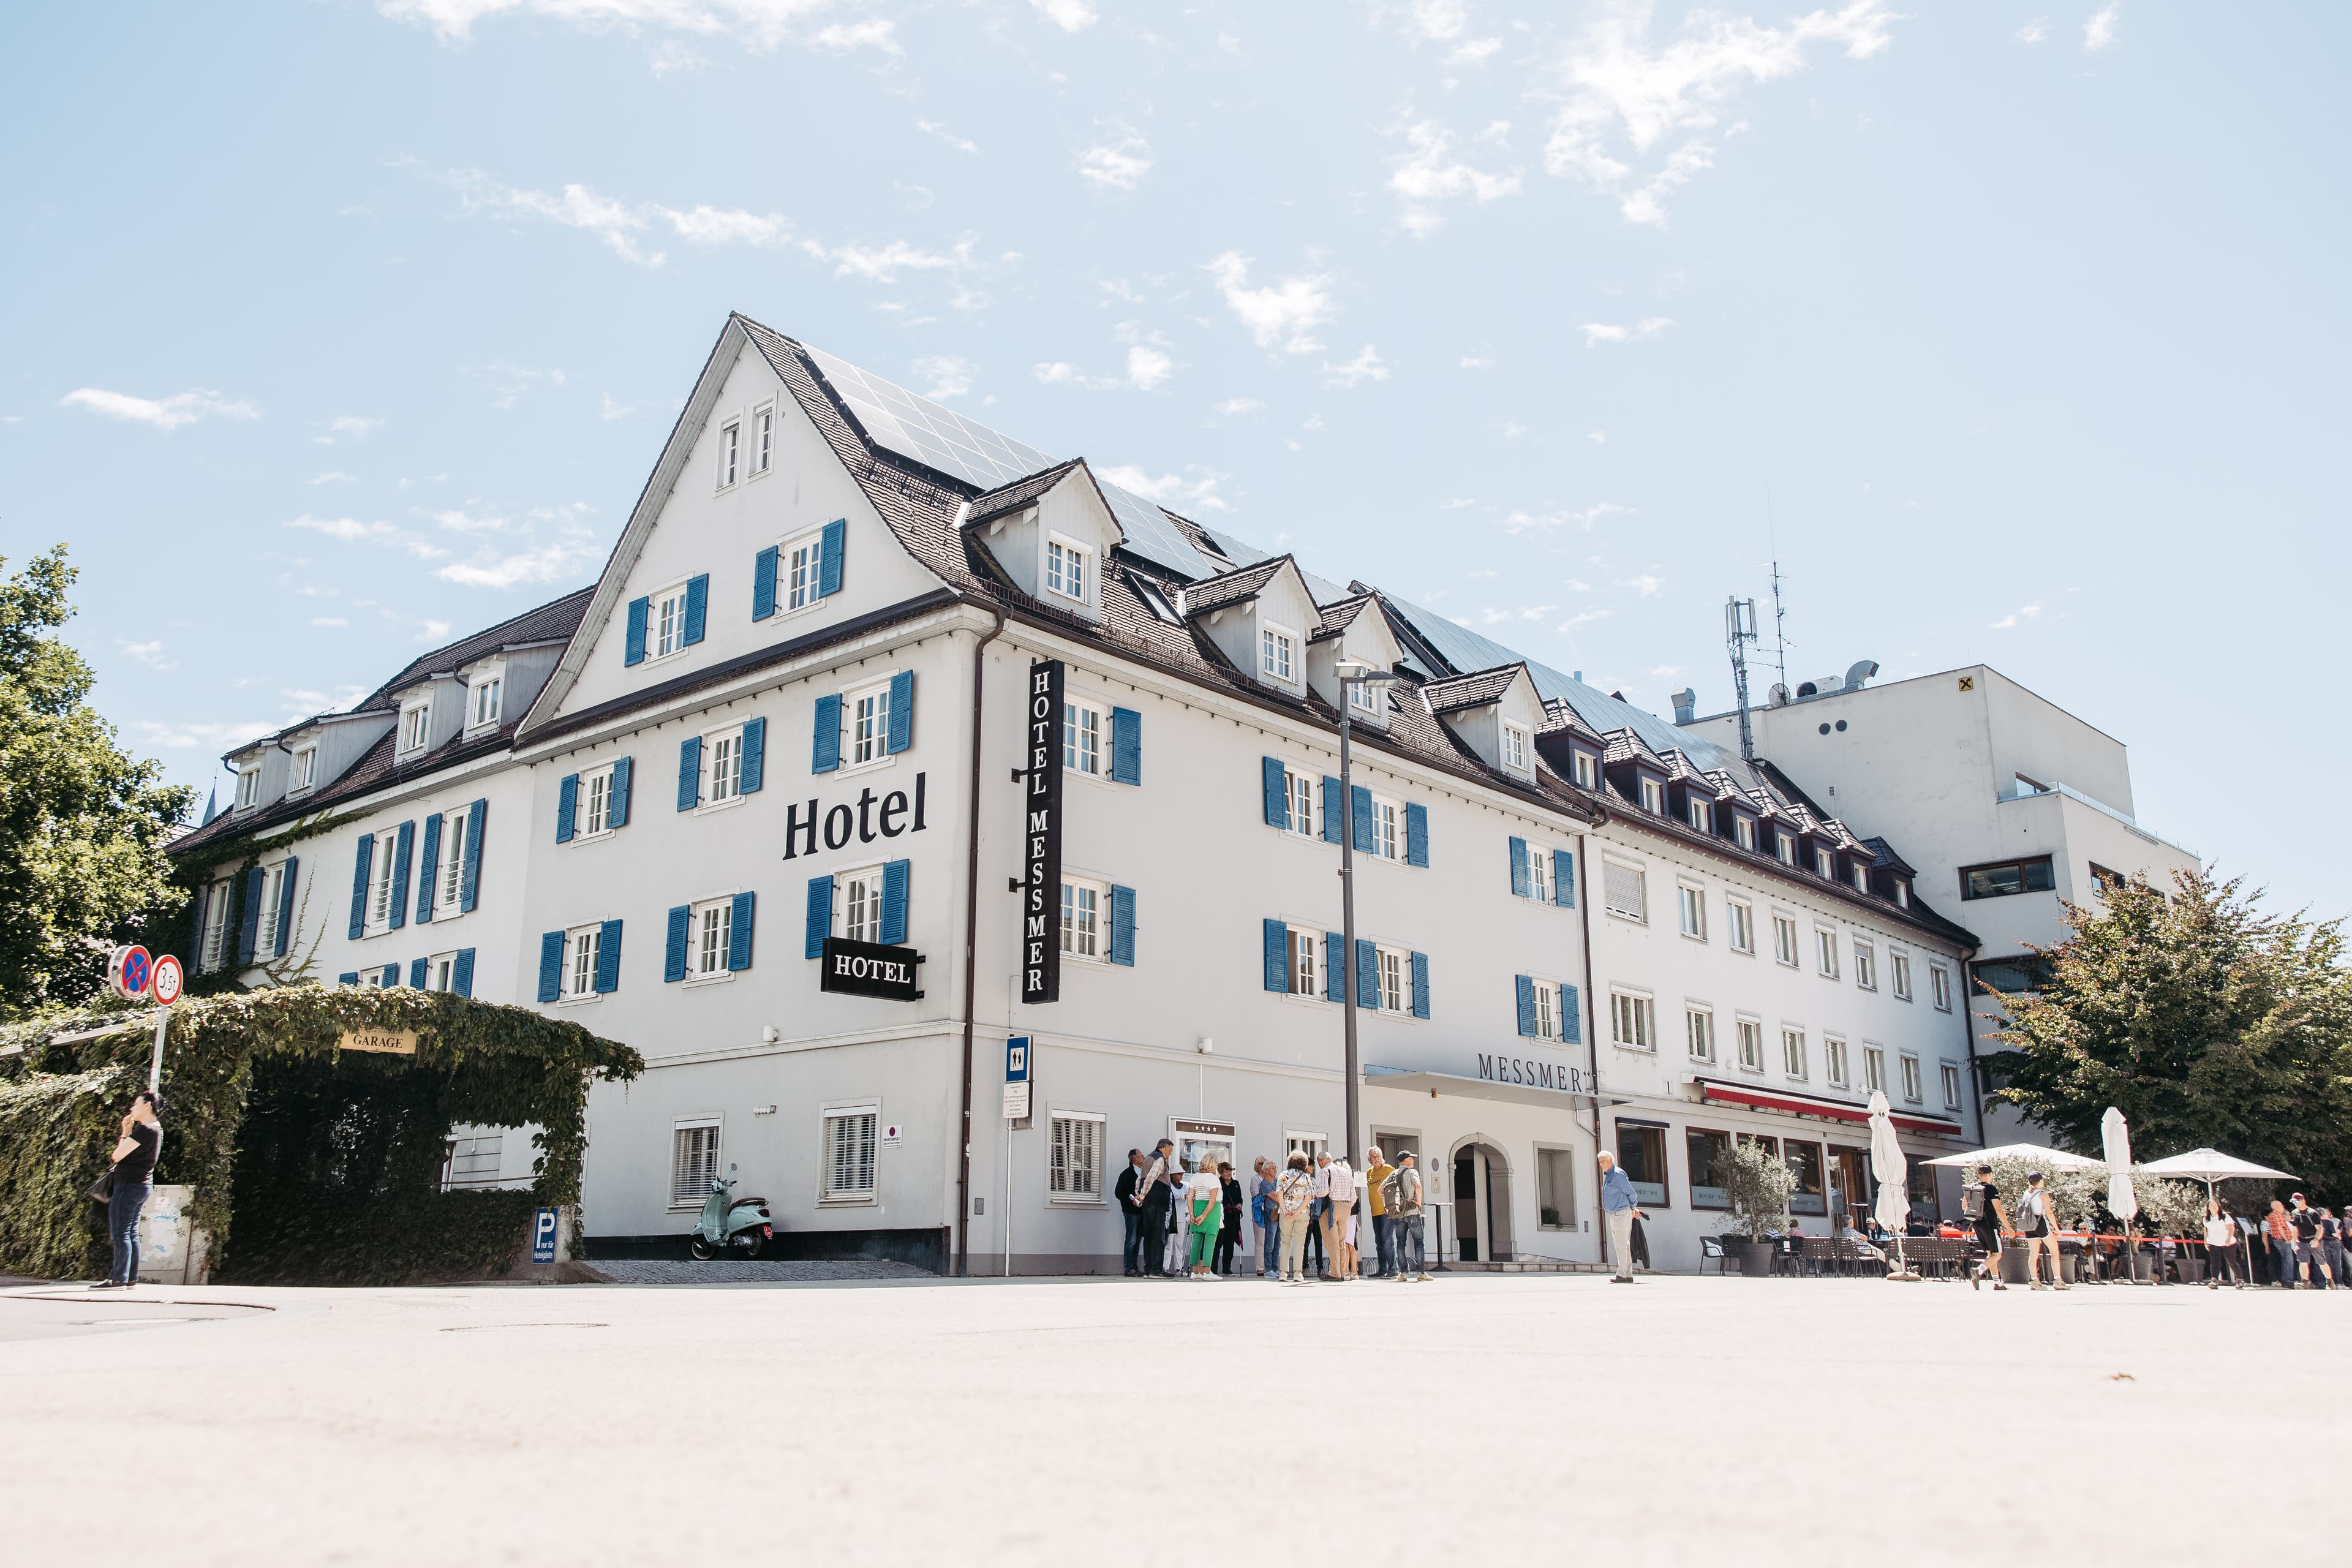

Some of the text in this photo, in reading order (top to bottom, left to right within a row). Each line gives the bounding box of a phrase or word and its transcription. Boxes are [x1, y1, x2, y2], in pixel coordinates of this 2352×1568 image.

[782, 772, 927, 861] Hotel
[1027, 671, 1050, 992] HOTEL MESSMER
[834, 954, 911, 984] HOTEL
[353, 1035, 403, 1048] GARAGE
[1478, 1053, 1582, 1092] MESSMER
[537, 1213, 556, 1248] P
[534, 1251, 553, 1261] Hotelgäste
